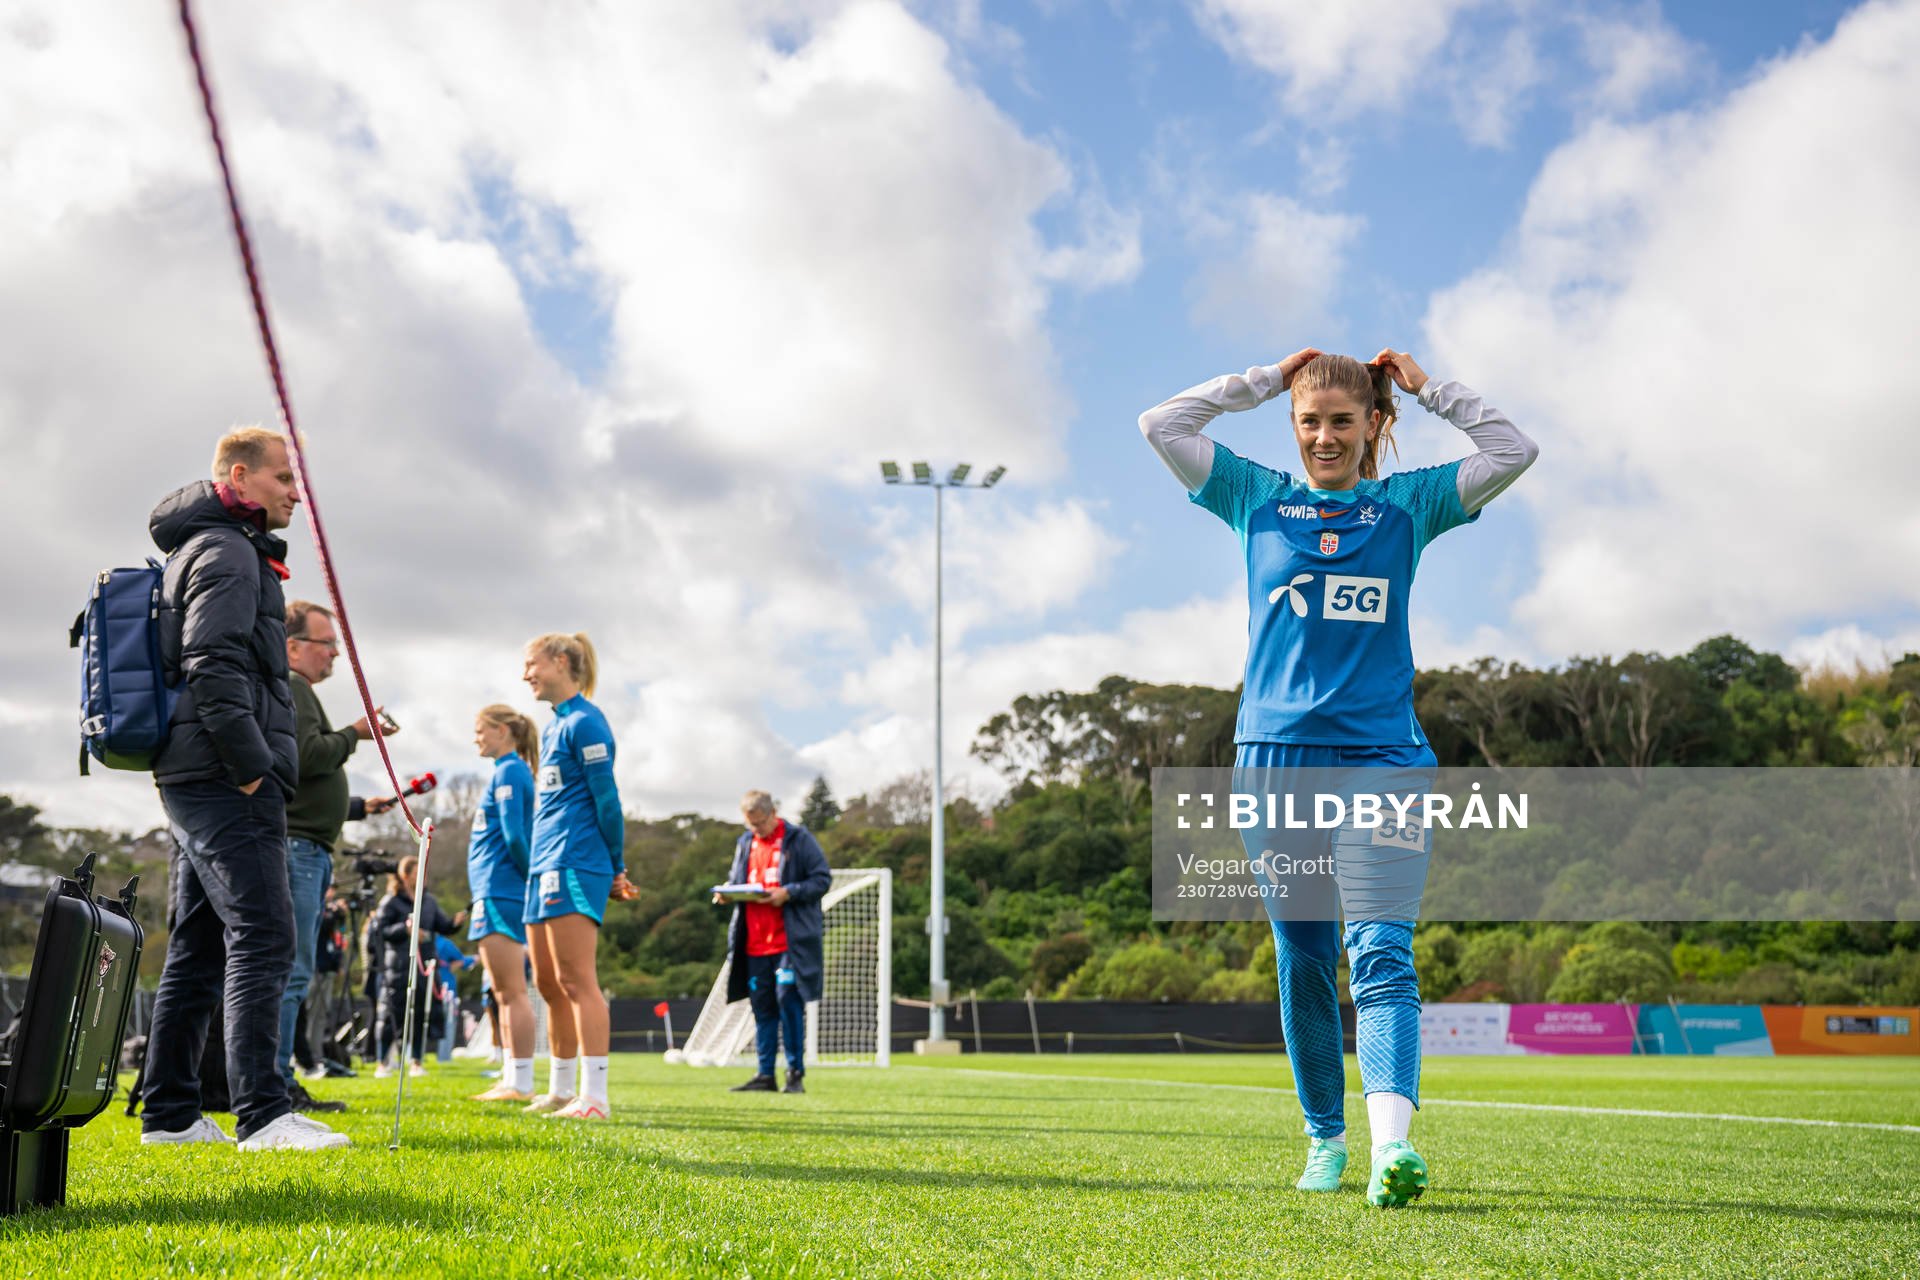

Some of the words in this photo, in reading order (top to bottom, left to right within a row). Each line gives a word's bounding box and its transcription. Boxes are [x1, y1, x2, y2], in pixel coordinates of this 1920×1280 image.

[1277, 504, 1306, 519] KIWI
[1331, 585, 1381, 613] 5G
[1379, 817, 1421, 843] 5G
